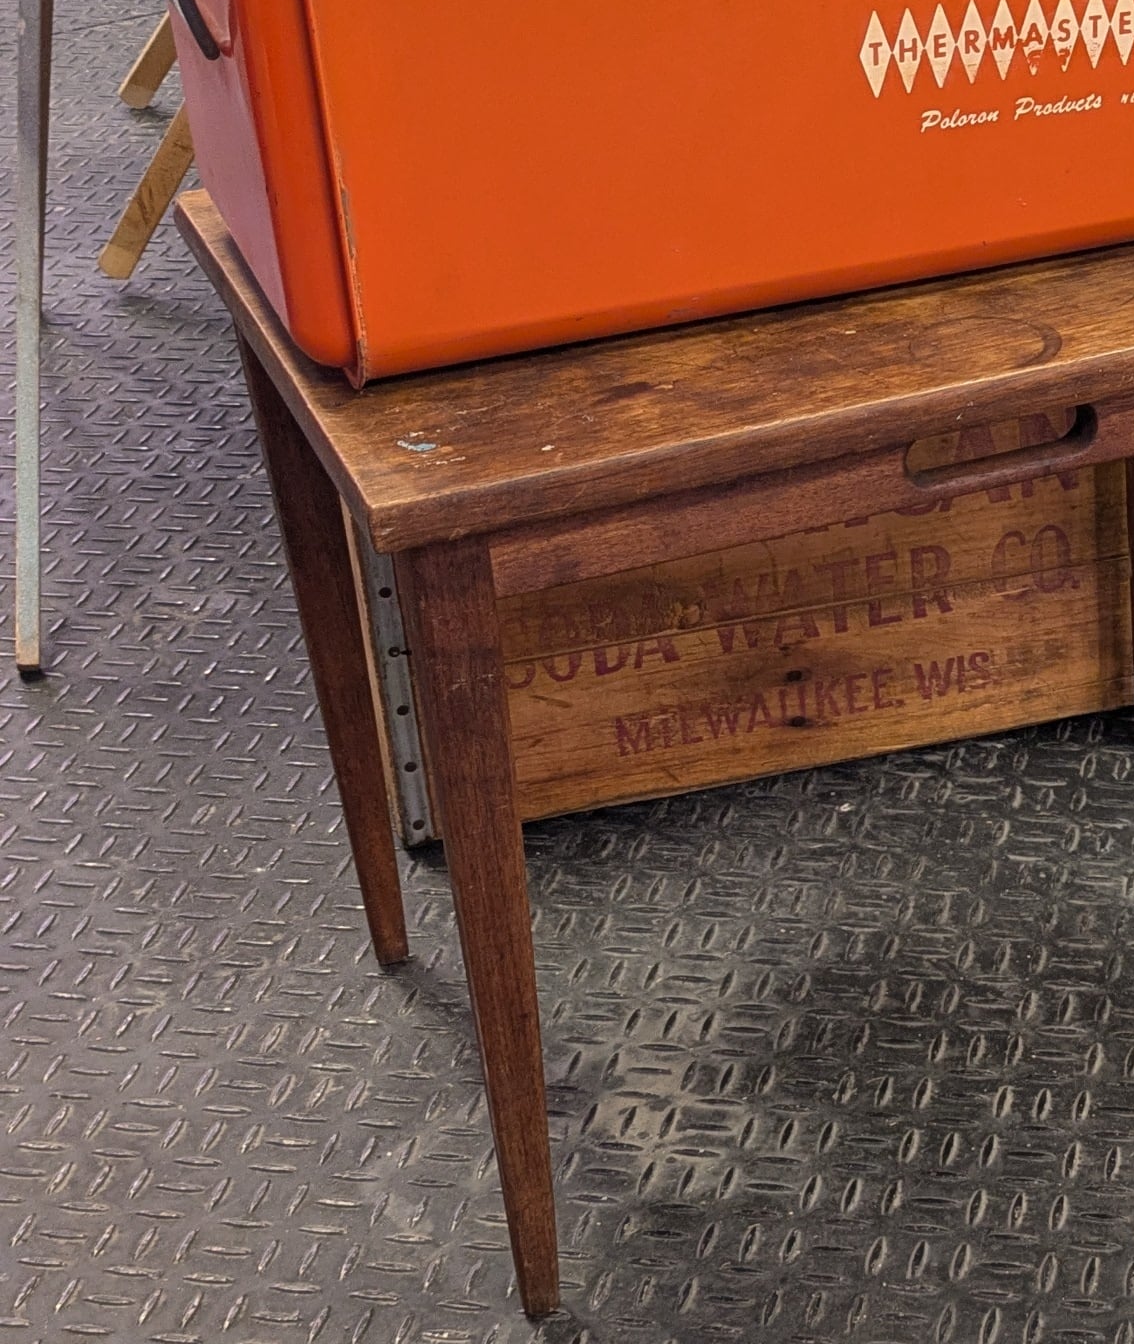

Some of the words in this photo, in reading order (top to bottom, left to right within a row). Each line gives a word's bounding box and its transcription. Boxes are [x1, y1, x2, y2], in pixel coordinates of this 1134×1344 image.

[920, 109, 1000, 133] Poloron
[1013, 94, 1102, 121] Products
[702, 543, 954, 654] WATER
